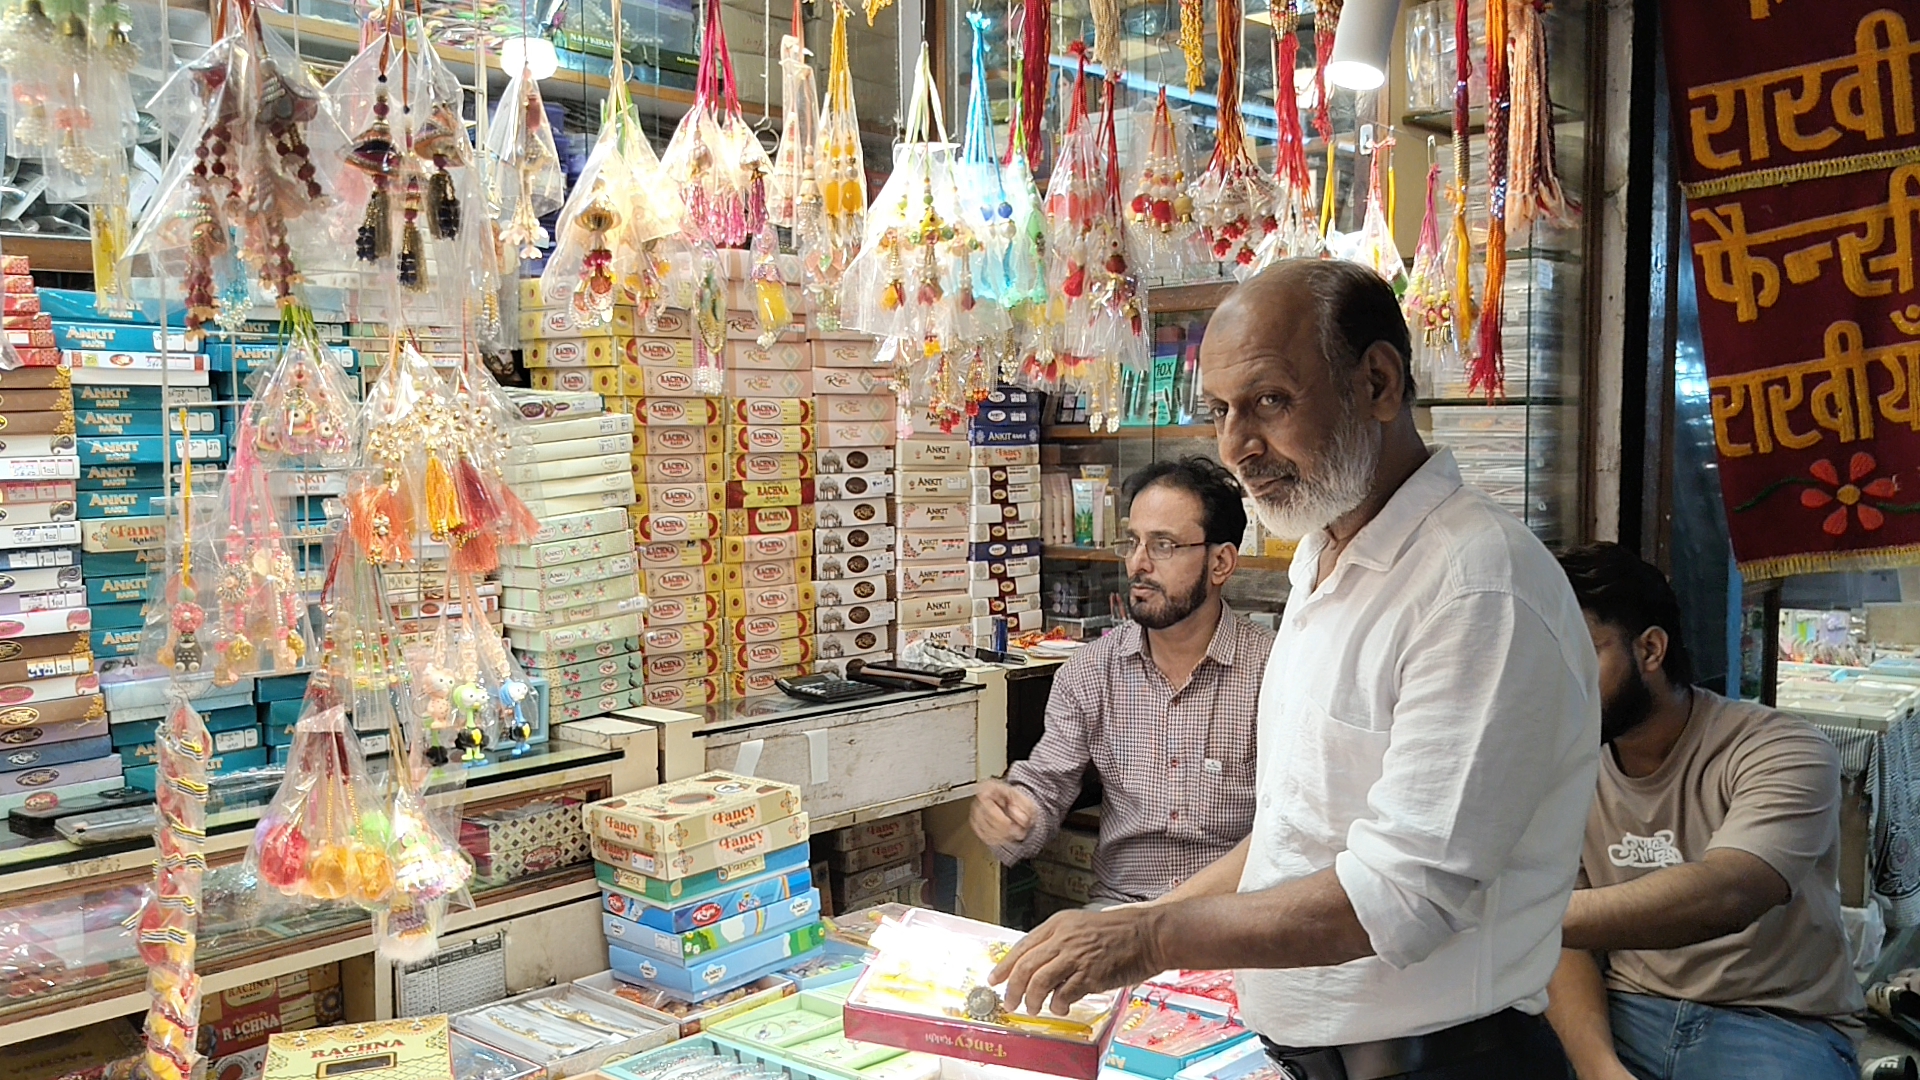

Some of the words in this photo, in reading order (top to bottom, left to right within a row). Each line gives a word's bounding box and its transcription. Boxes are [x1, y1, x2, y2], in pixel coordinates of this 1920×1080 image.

[66, 326, 116, 341] ANKIT
[643, 347, 672, 357] RACHNA
[660, 374, 690, 385] RACHNA
[81, 386, 130, 399] ANKIT
[652, 404, 681, 414] RACHNA
[752, 404, 780, 414] RACHNA
[83, 412, 133, 426] ANKIT
[662, 433, 691, 442] RACHNA
[753, 432, 780, 441] RACHNA
[988, 431, 1012, 441] ANKIT
[91, 440, 140, 454] ANKIT
[926, 445, 950, 454] ANKIT
[662, 462, 690, 471] RACHNA
[751, 460, 778, 469] RACHNA
[88, 466, 137, 480] ANKIT
[918, 478, 943, 486] ANKIT
[665, 491, 693, 501] RACHNA
[757, 485, 789, 496] RACHNA
[89, 493, 138, 507] ANKIT
[758, 510, 789, 522] RACHNA
[926, 507, 948, 515] ANKIT
[655, 519, 684, 530] RACHNA
[918, 538, 940, 546] ANKIT
[661, 573, 690, 584] RACHNA
[756, 568, 783, 578] RACHNA
[919, 570, 940, 579] ANKIT
[101, 577, 149, 593] ANKIT
[760, 595, 786, 605] RACHNA
[652, 602, 682, 613] RACHNA
[926, 602, 951, 611] ANKIT
[749, 621, 777, 632] RACHNA
[103, 631, 142, 646] ANKI
[930, 631, 951, 640] ANKIT
[752, 648, 778, 659] RACHNA
[652, 658, 683, 671] RACHNA
[651, 688, 681, 702] RACHNA
[713, 804, 756, 825] Fancy
[605, 816, 638, 838] Fancy
[719, 830, 763, 850] Fancy
[311, 1039, 406, 1059] RACHNA
[956, 1033, 1008, 1058] Fancy
